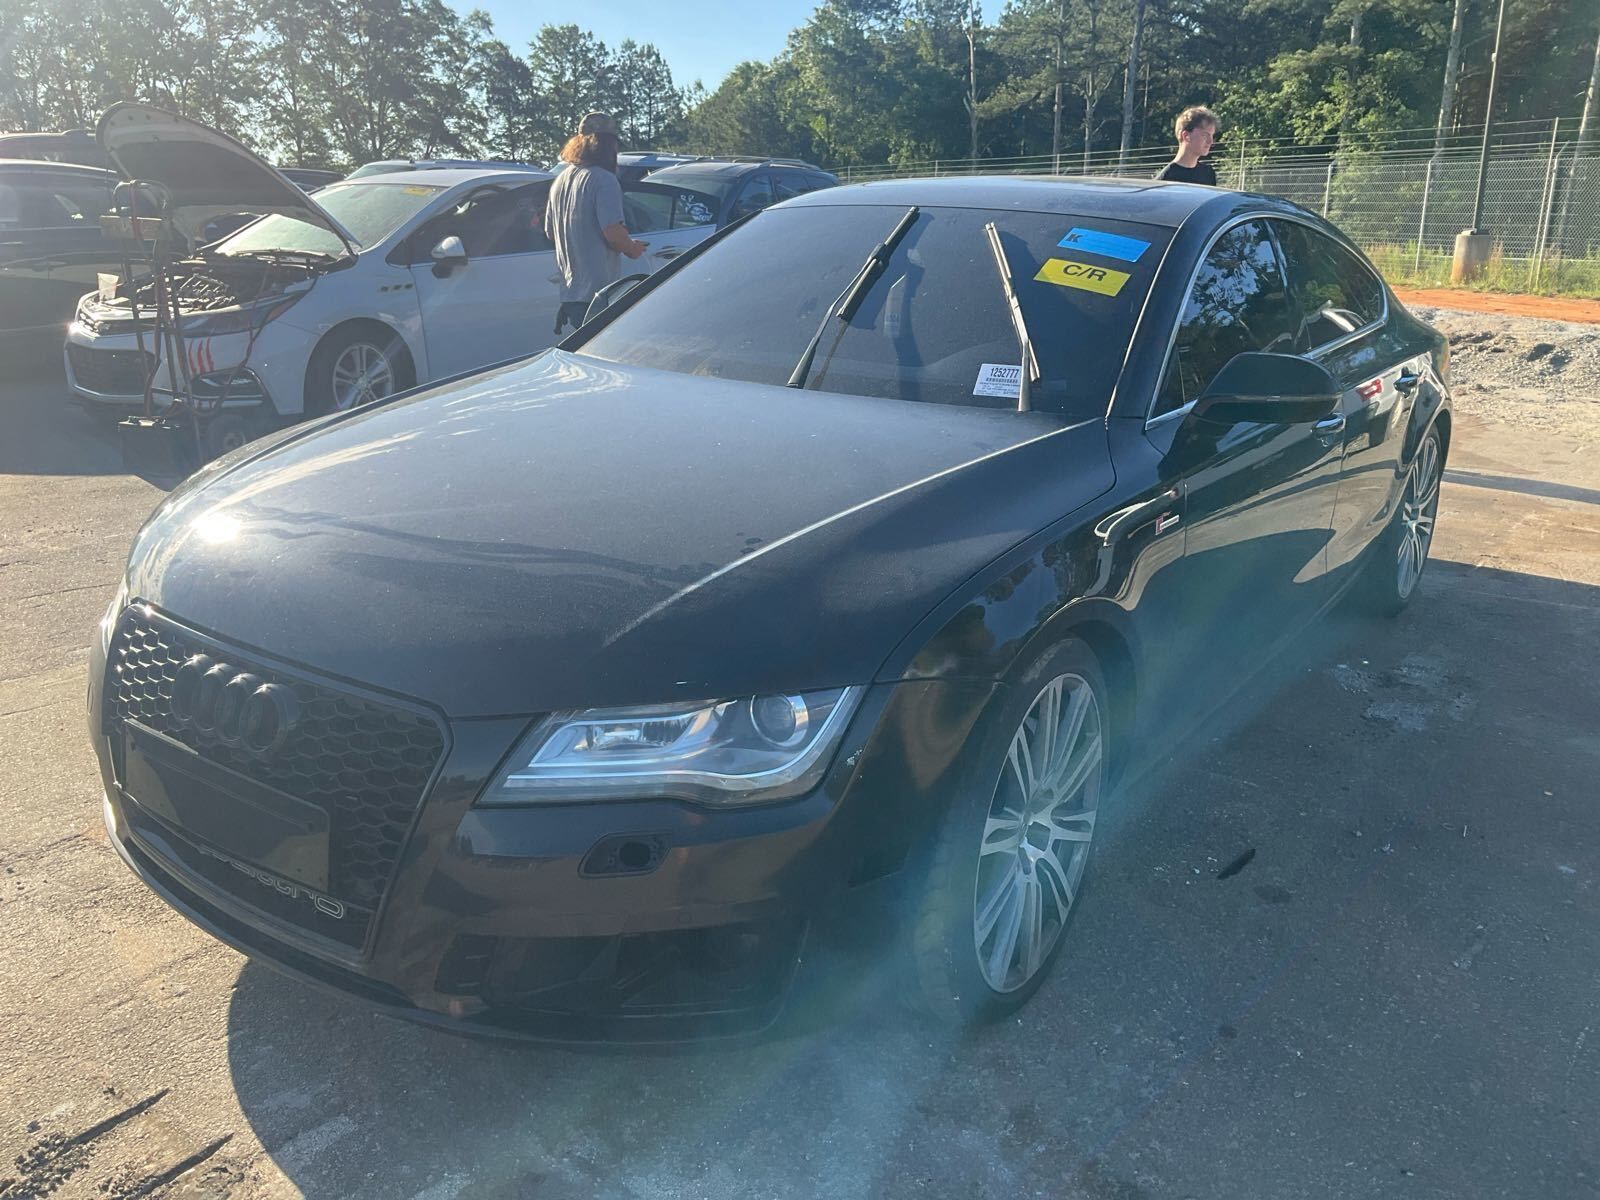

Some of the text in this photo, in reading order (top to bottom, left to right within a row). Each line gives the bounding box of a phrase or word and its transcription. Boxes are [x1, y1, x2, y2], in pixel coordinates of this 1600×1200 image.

[1066, 234, 1083, 243] K
[1063, 264, 1107, 282] C/R
[990, 368, 1019, 379] 1252777
